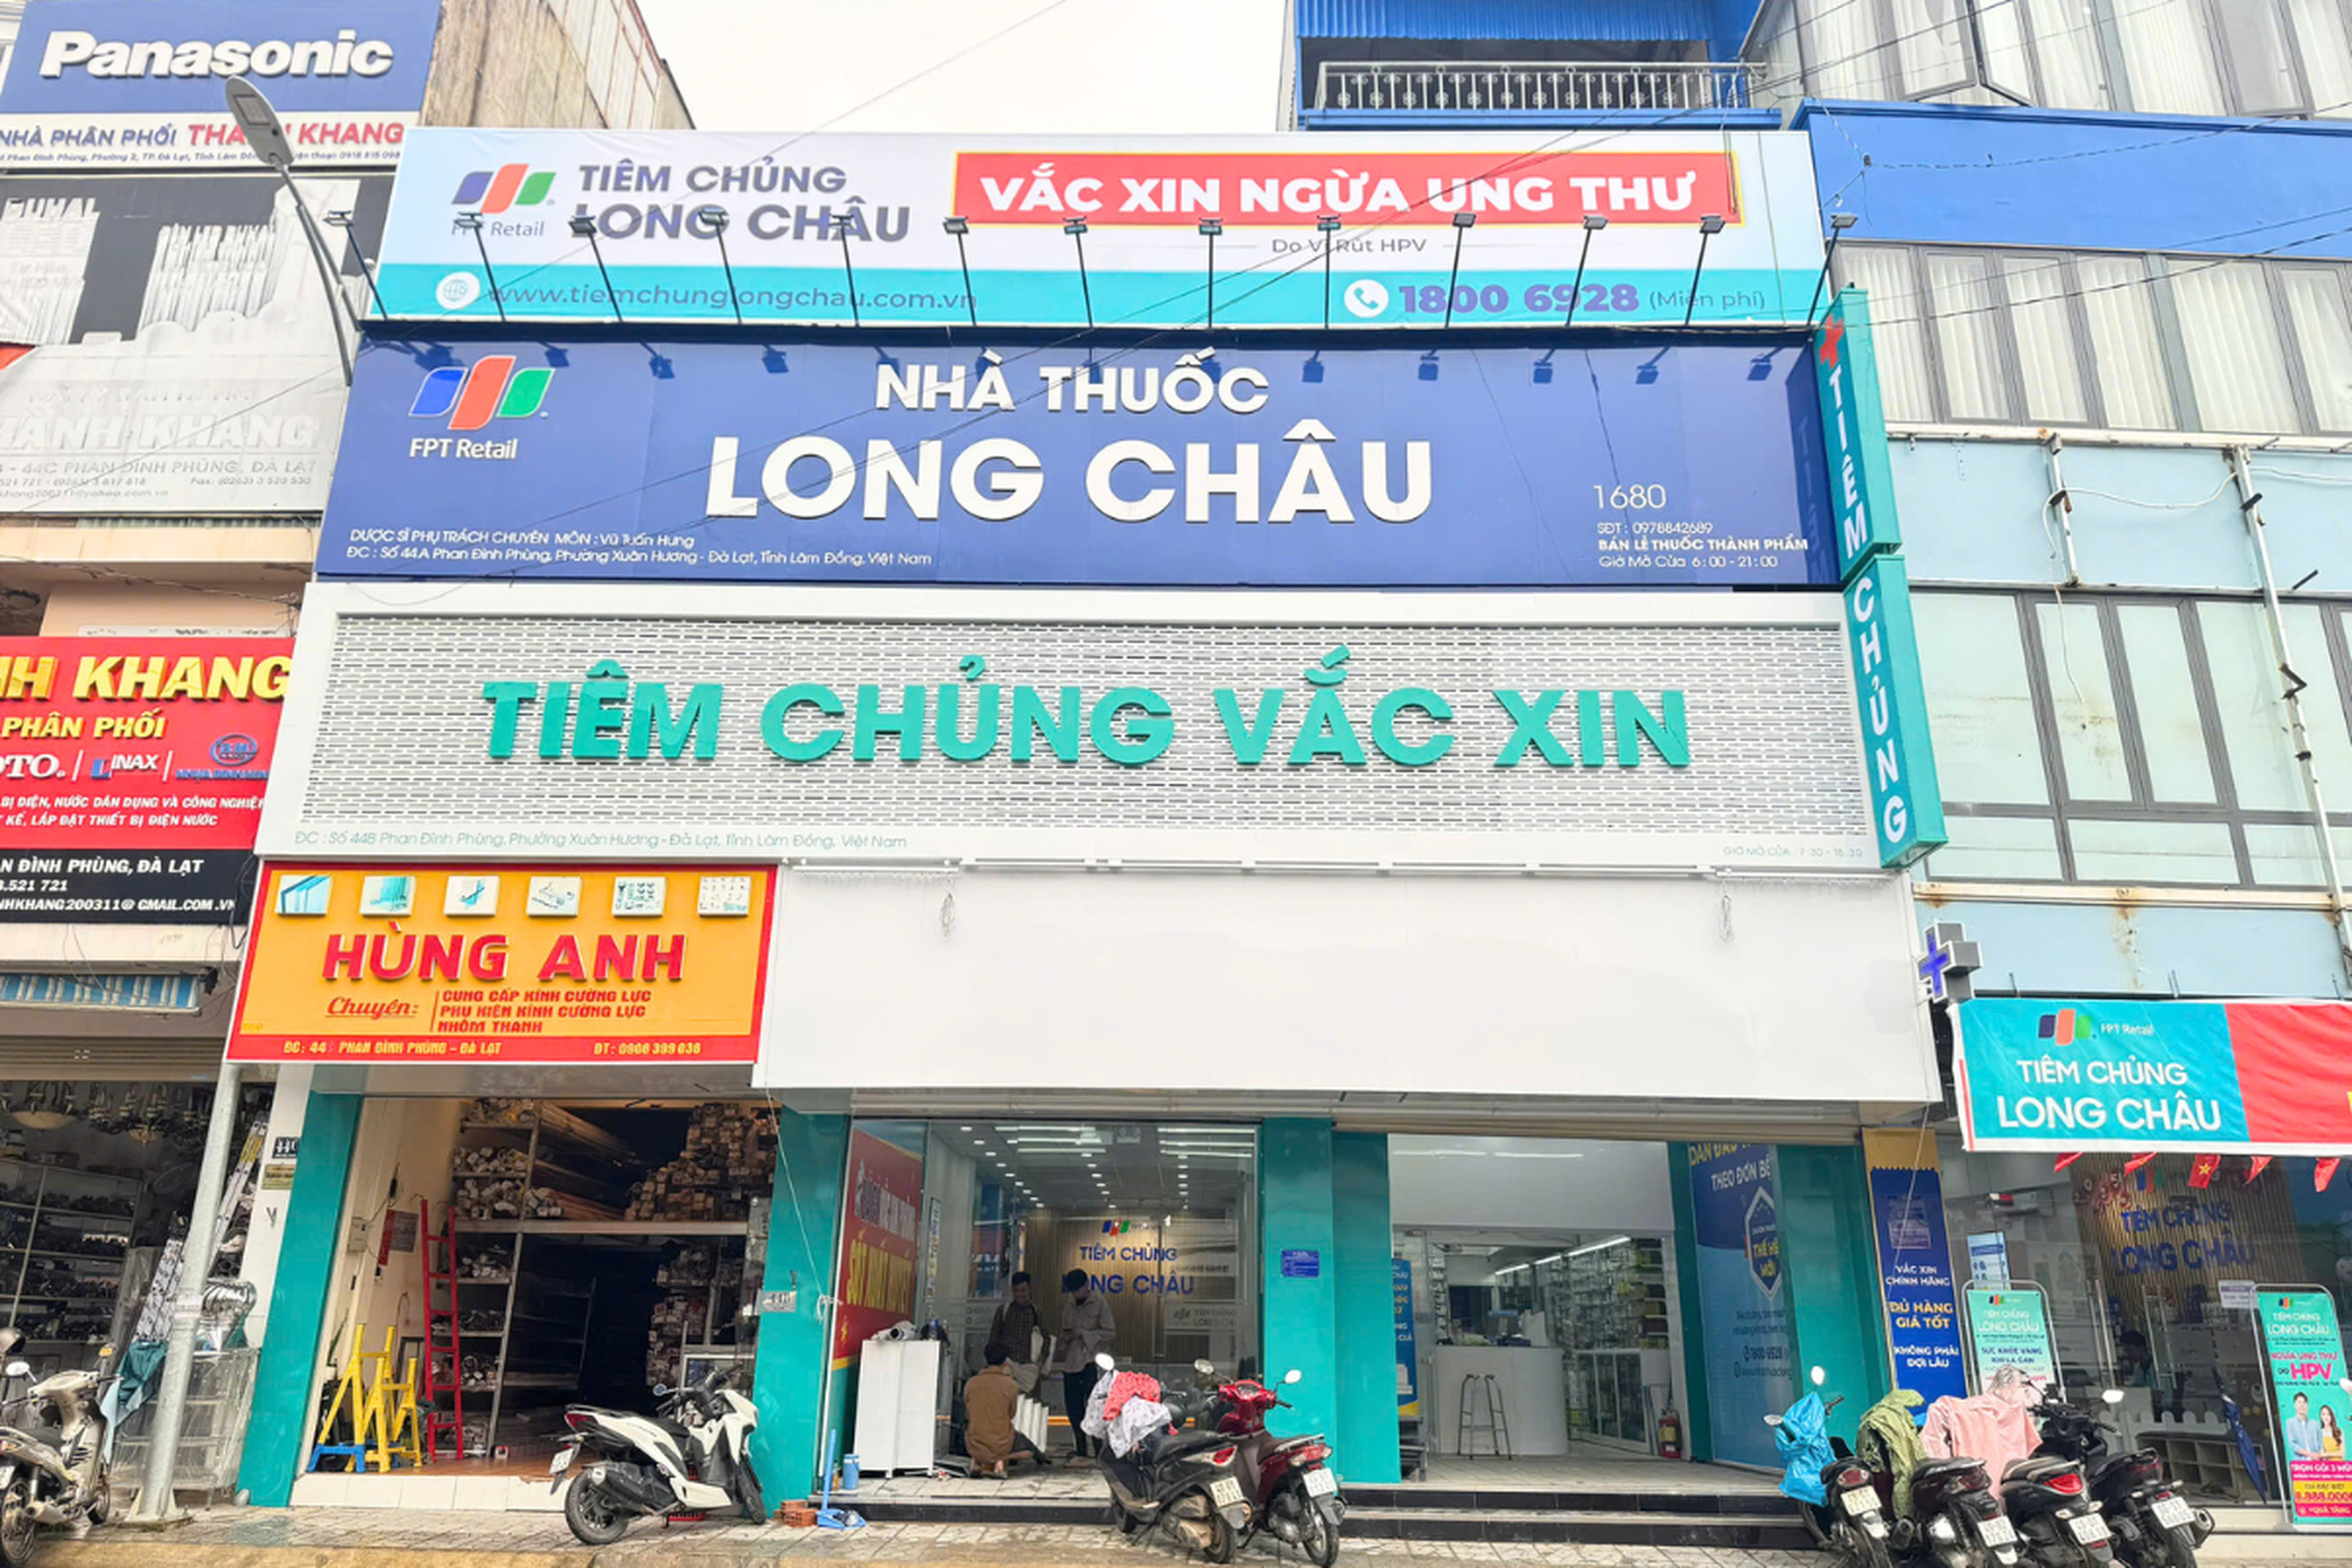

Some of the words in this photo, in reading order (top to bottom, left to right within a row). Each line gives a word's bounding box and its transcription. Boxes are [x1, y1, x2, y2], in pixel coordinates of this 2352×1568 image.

[40, 28, 394, 78] Panasonic
[0, 125, 43, 147] NHÀ
[50, 125, 115, 147] PHÂN
[120, 123, 177, 147] PHỐI
[298, 122, 404, 145] KHANG
[578, 157, 672, 192] TIÊM
[685, 155, 847, 193] CHỦNG
[981, 164, 1102, 213] VẮC
[1118, 177, 1219, 213] XIN
[1239, 167, 1409, 213] NGỪA
[1429, 176, 1562, 213] UNG
[1571, 171, 1695, 211] THƯ
[492, 220, 544, 237] Retail
[747, 194, 909, 243] CHÂU
[1272, 238, 1301, 254] Do
[1380, 238, 1426, 254] HPV
[1399, 285, 1510, 314] 1800
[1523, 285, 1637, 314] 6928
[1721, 286, 1765, 311] phí)
[875, 348, 1015, 411] NHÀ
[1040, 345, 1269, 413] THUỐC
[410, 438, 450, 458] FPT
[456, 438, 517, 459] Retail
[705, 435, 1044, 521] LONG
[1086, 419, 1431, 524] CHÂU
[1593, 484, 1668, 509] 1680
[443, 528, 489, 544] TRÁCH
[492, 529, 548, 544] CHUYÊN
[555, 529, 591, 545] MÔN
[1599, 536, 1629, 550] BÁN
[1651, 535, 1703, 550] THUỐC
[1707, 536, 1759, 550] THÀNH
[1764, 533, 1808, 550] PHẨM
[380, 546, 398, 559] Số
[432, 548, 469, 560] Phan
[472, 547, 502, 560] Đình
[505, 549, 551, 563] Phùng,
[611, 549, 648, 562] Xuân
[732, 551, 757, 565] Lạt,
[790, 550, 820, 564] Lâm
[868, 551, 893, 566] Việt
[899, 553, 932, 565] Nam
[73, 655, 292, 703] KHANG
[482, 659, 724, 760] TIÊM
[760, 655, 1174, 766] CHỦNG
[1213, 644, 1454, 766] VẮC
[1493, 688, 1691, 769] XIN
[3, 712, 83, 739] PHÂN
[94, 707, 166, 739] PHỐI
[122, 796, 159, 810] DỤNG
[163, 795, 178, 808] VÀ
[89, 812, 126, 826] THIẾT
[148, 814, 177, 828] ĐIỆN
[380, 831, 416, 844] Phan
[420, 831, 453, 845] Đình
[569, 832, 607, 845] Xuân
[695, 833, 720, 849] Lạt,
[757, 833, 788, 847] Lâm
[842, 834, 868, 849] Việt
[872, 836, 906, 848] Nam
[17, 855, 62, 873] ĐÌNH
[67, 855, 133, 875] PHÙNG,
[138, 855, 162, 873] ĐÀ
[168, 859, 204, 876] LẠT
[40, 879, 68, 891] 721
[322, 921, 510, 983] HÙNG
[537, 933, 686, 983] ANH
[442, 990, 484, 1003] CUNG
[489, 987, 519, 1003] CẤP
[524, 988, 561, 1003] KÍNH
[564, 988, 618, 1003] CƯỜNG
[620, 990, 651, 1006] LỰC
[325, 997, 419, 1021] Chuyên:
[476, 1004, 511, 1020] KIỆN
[515, 1004, 554, 1019] KÍNH
[558, 1003, 611, 1019] CƯỜNG
[615, 1005, 646, 1021] LỰC
[437, 1020, 488, 1033] NHÔM
[492, 1021, 542, 1033] THANH
[2101, 1023, 2120, 1035] FPT
[2122, 1022, 2154, 1036] Retail
[338, 1041, 371, 1054] PHAN
[2017, 1054, 2080, 1084] TIÊM
[2086, 1055, 2188, 1086] CHỦNG
[1997, 1095, 2106, 1129] LONG
[2116, 1089, 2222, 1131] CHÂU
[1080, 1242, 1115, 1261] TIÊM
[1120, 1242, 1178, 1261] CHỦNG
[1919, 1264, 1937, 1275] XIN
[1133, 1269, 1194, 1294] CHÂU
[1889, 1298, 1909, 1314] ĐỦ
[1913, 1298, 1953, 1314] HÀNG
[1896, 1313, 1920, 1328] GIÁ
[1924, 1313, 1951, 1329] TỐT
[2290, 1362, 2332, 1381] HPV
